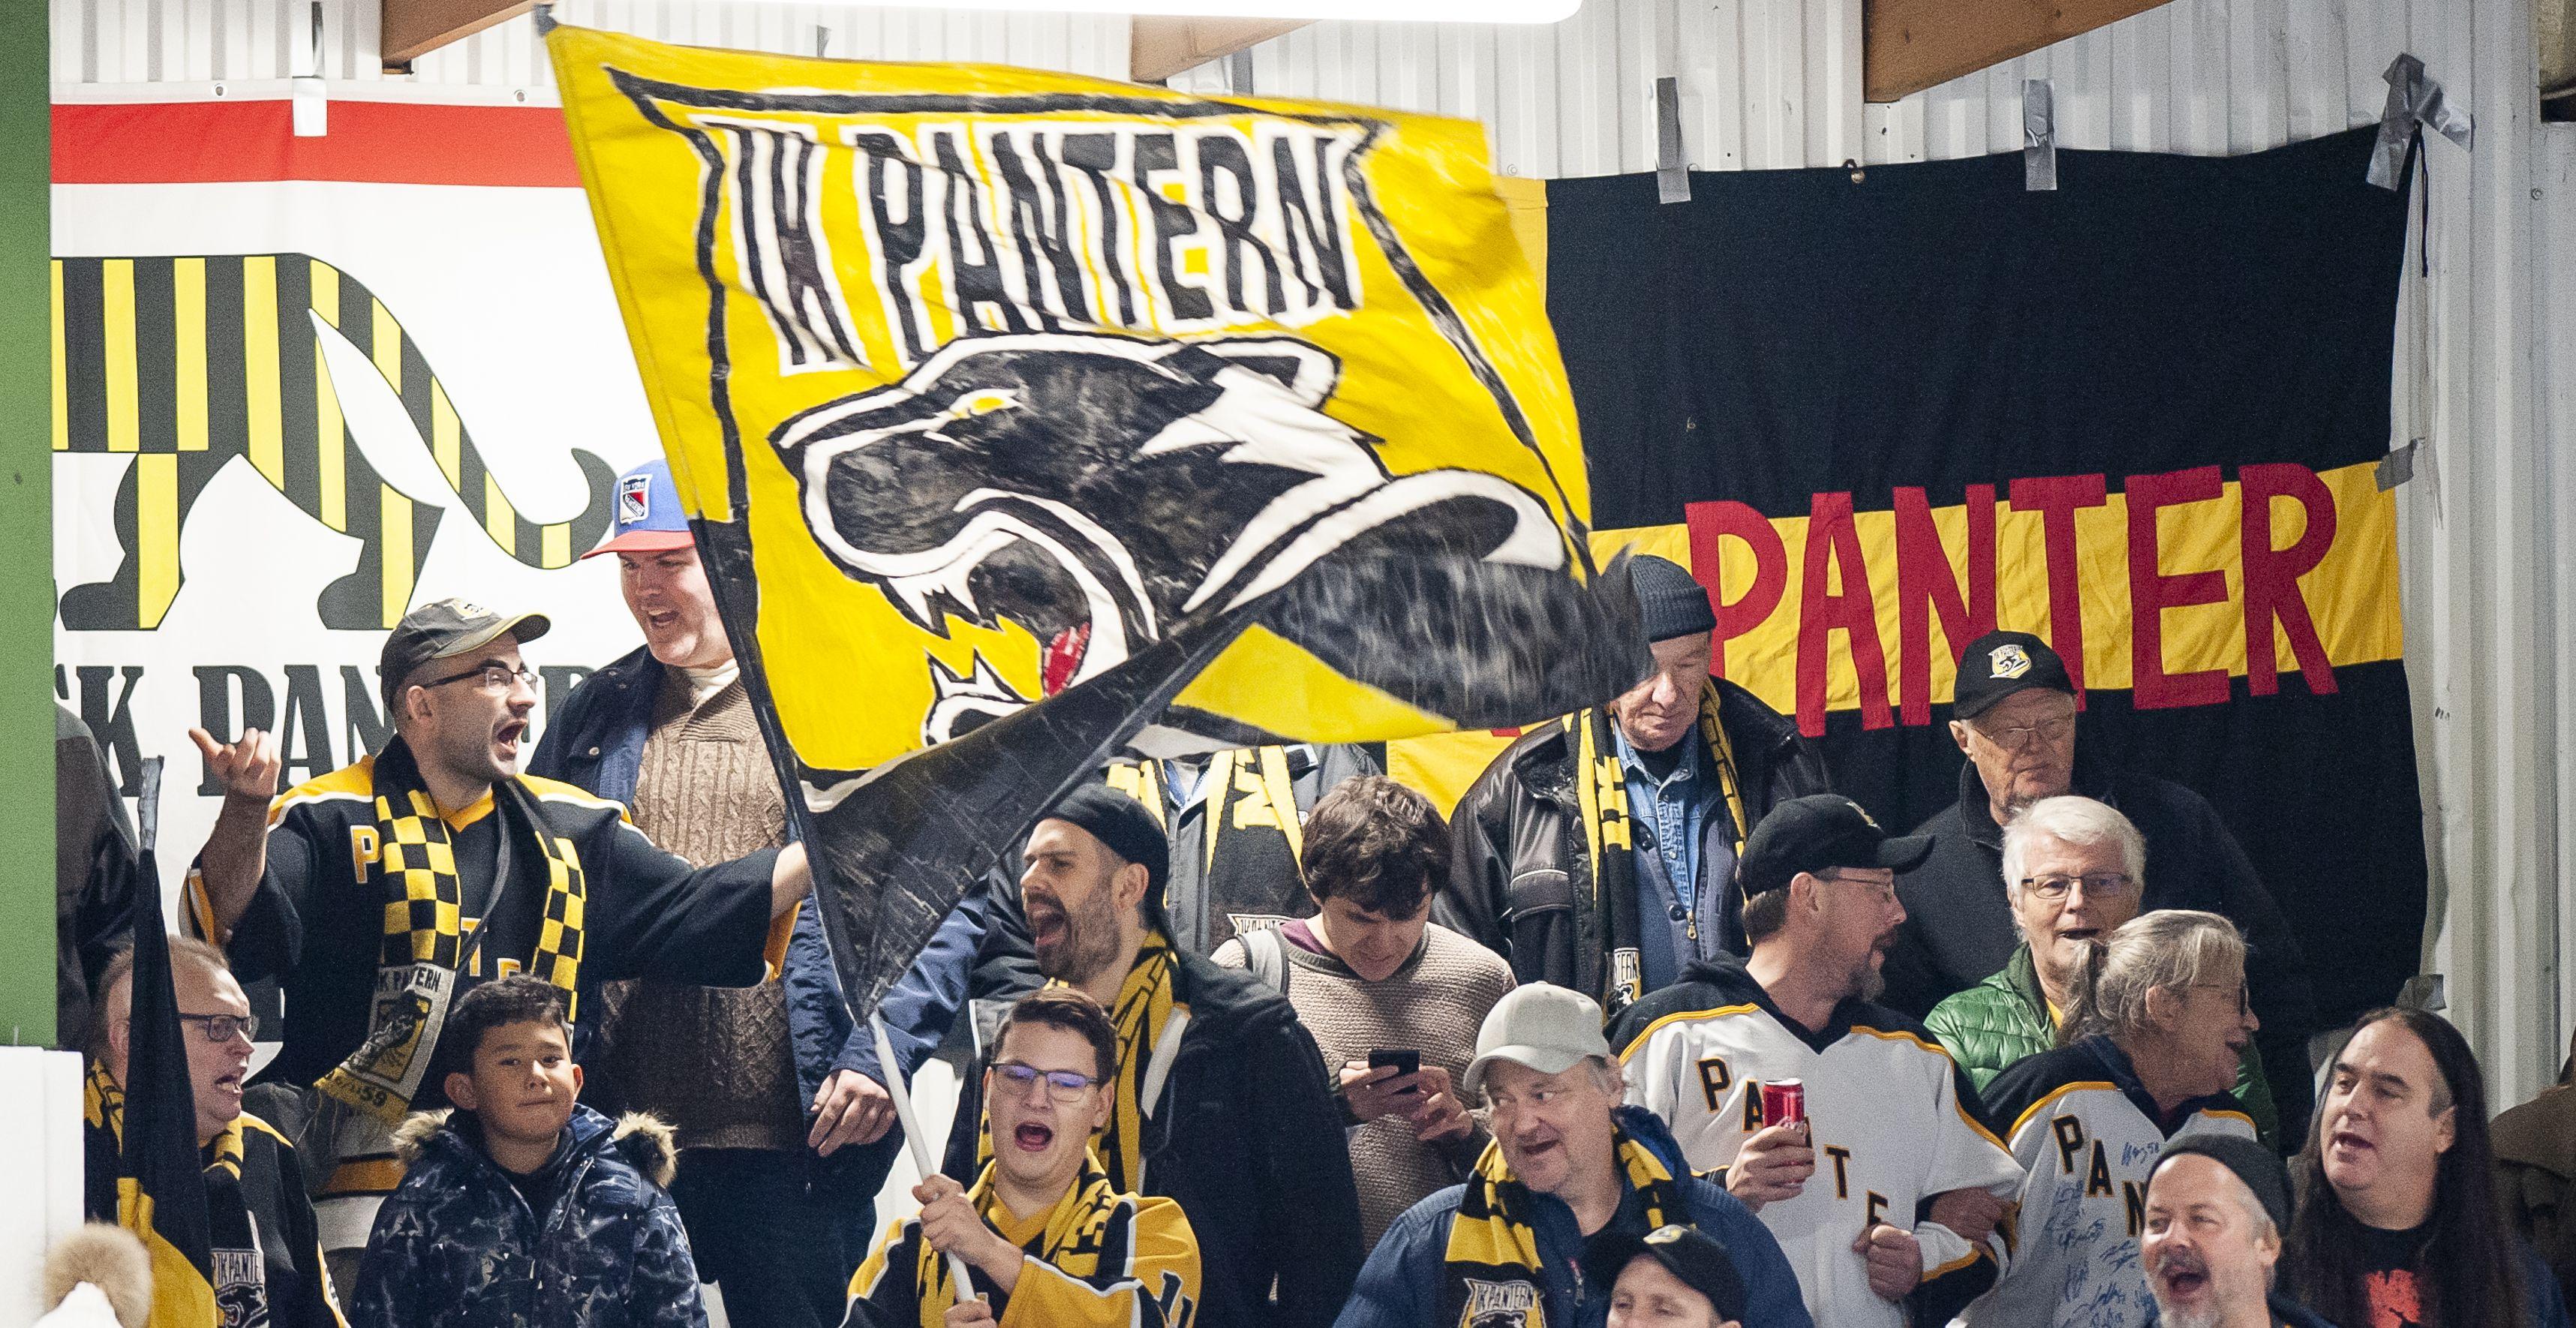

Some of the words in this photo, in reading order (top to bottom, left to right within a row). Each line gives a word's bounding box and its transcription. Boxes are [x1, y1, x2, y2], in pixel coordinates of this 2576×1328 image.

[728, 119, 872, 372] IK
[846, 124, 1360, 363] PANTERN
[1685, 463, 2339, 737] PANTER
[55, 663, 145, 797] K
